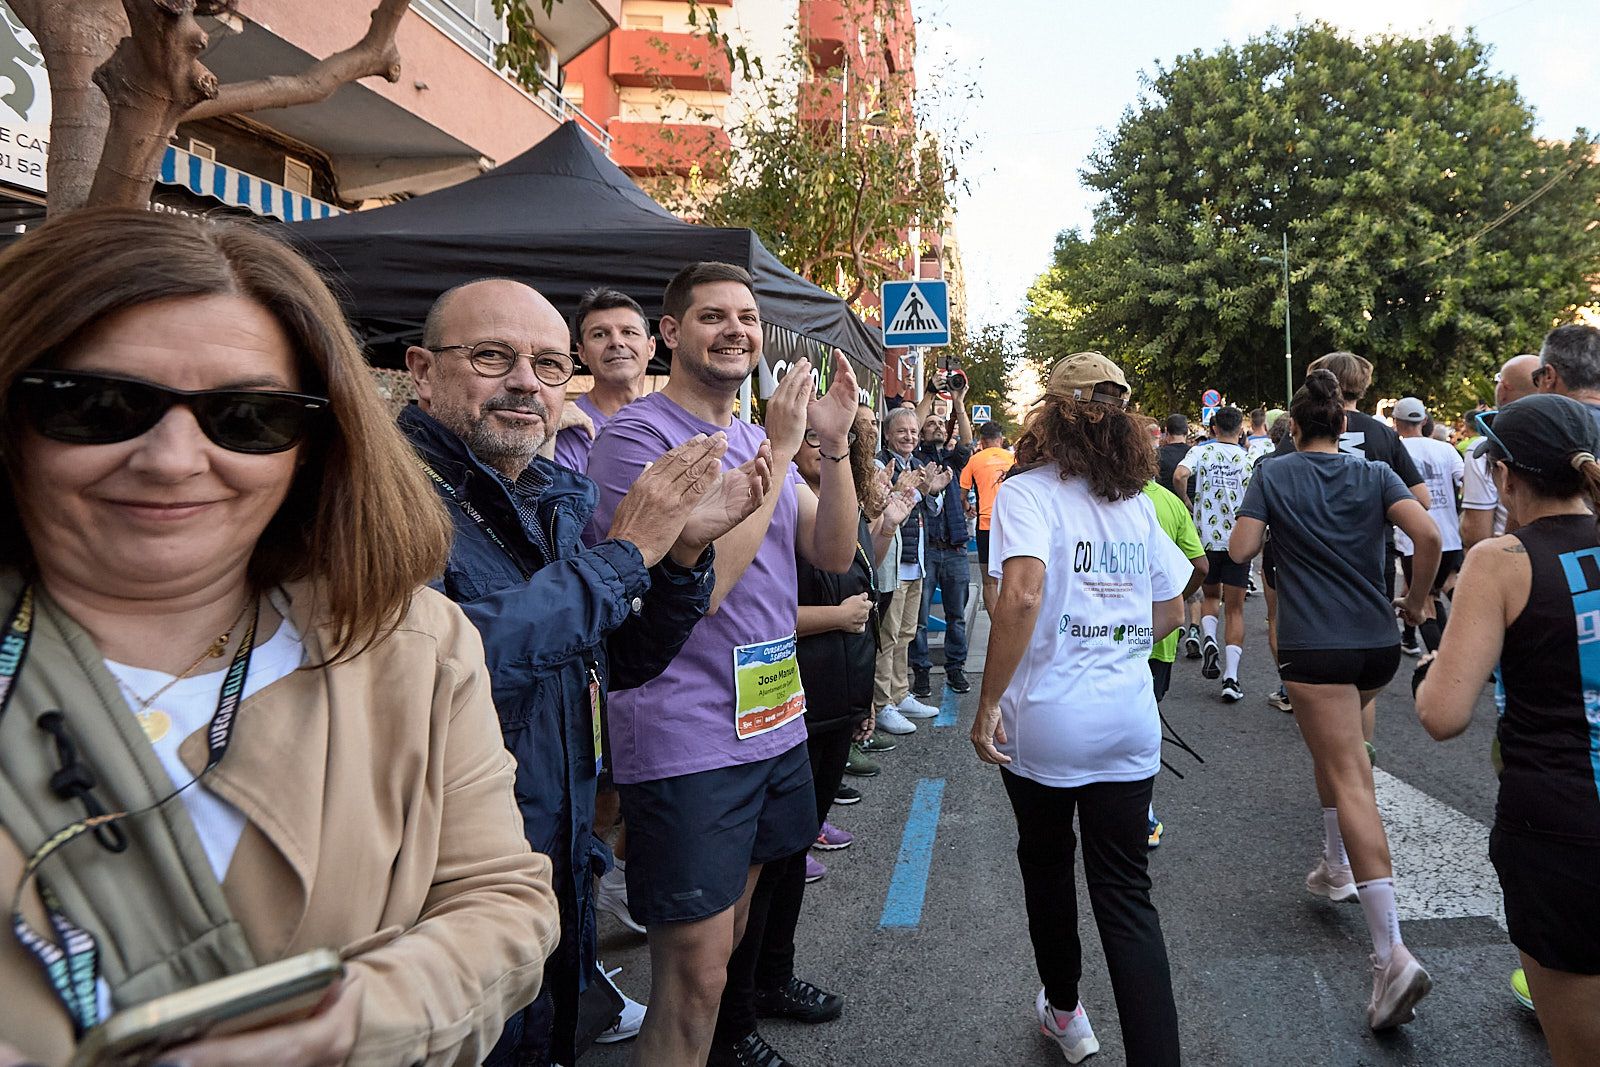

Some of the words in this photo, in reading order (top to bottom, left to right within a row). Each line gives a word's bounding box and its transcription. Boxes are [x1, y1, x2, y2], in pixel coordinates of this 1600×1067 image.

[17, 158, 41, 177] 52
[1073, 541, 1145, 574] COLABORO
[1071, 624, 1108, 638] auna
[758, 674, 778, 686] Jose
[211, 693, 240, 750] JUEGAN
